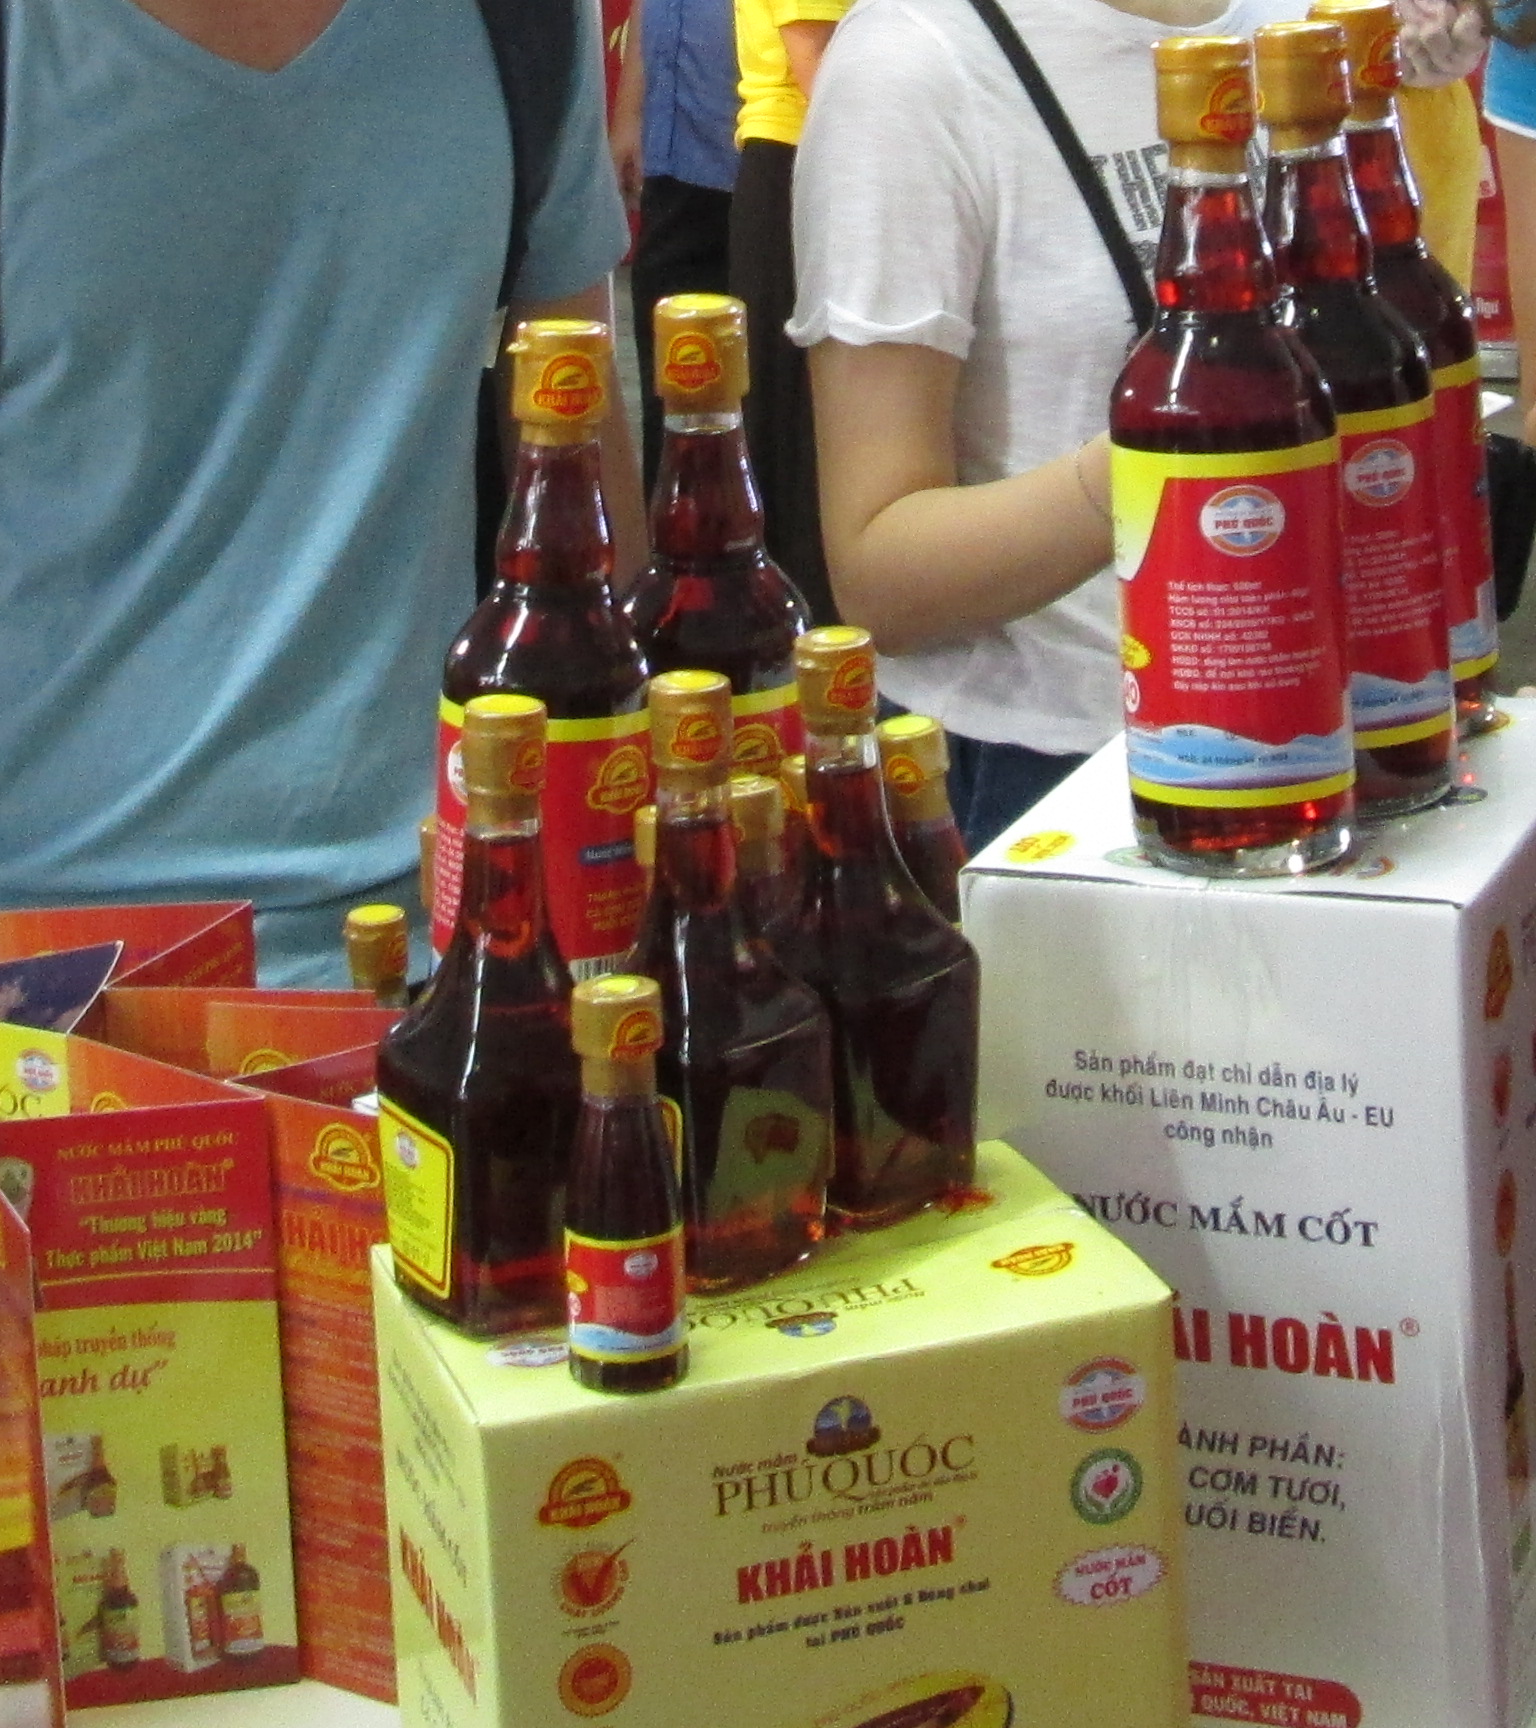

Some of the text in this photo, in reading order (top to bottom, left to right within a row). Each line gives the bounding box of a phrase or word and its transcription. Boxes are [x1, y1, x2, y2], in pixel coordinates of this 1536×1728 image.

[1074, 1049, 1113, 1073] Sản
[1120, 1051, 1176, 1080] phẩm
[1183, 1060, 1215, 1081] đạt
[1258, 1062, 1297, 1089] dẫn
[1304, 1070, 1336, 1093] địa
[1342, 1072, 1360, 1098] lý
[1045, 1079, 1093, 1102] được
[1100, 1082, 1144, 1106] khối
[1150, 1087, 1194, 1111] Liên
[1200, 1091, 1250, 1115] Minh
[1256, 1096, 1311, 1121] Châu
[1317, 1097, 1346, 1123] Âu
[1365, 1106, 1395, 1128] EU
[1164, 1122, 1273, 1151] công nhận
[1188, 1194, 1287, 1240] MẮM
[1297, 1206, 1379, 1248] CỐT
[1227, 1309, 1396, 1385] HOÀN
[39, 1368, 101, 1398] anh
[1177, 1422, 1240, 1456] ÀNH
[1184, 1498, 1238, 1532] UỐI
[737, 1539, 834, 1604] KHẢI
